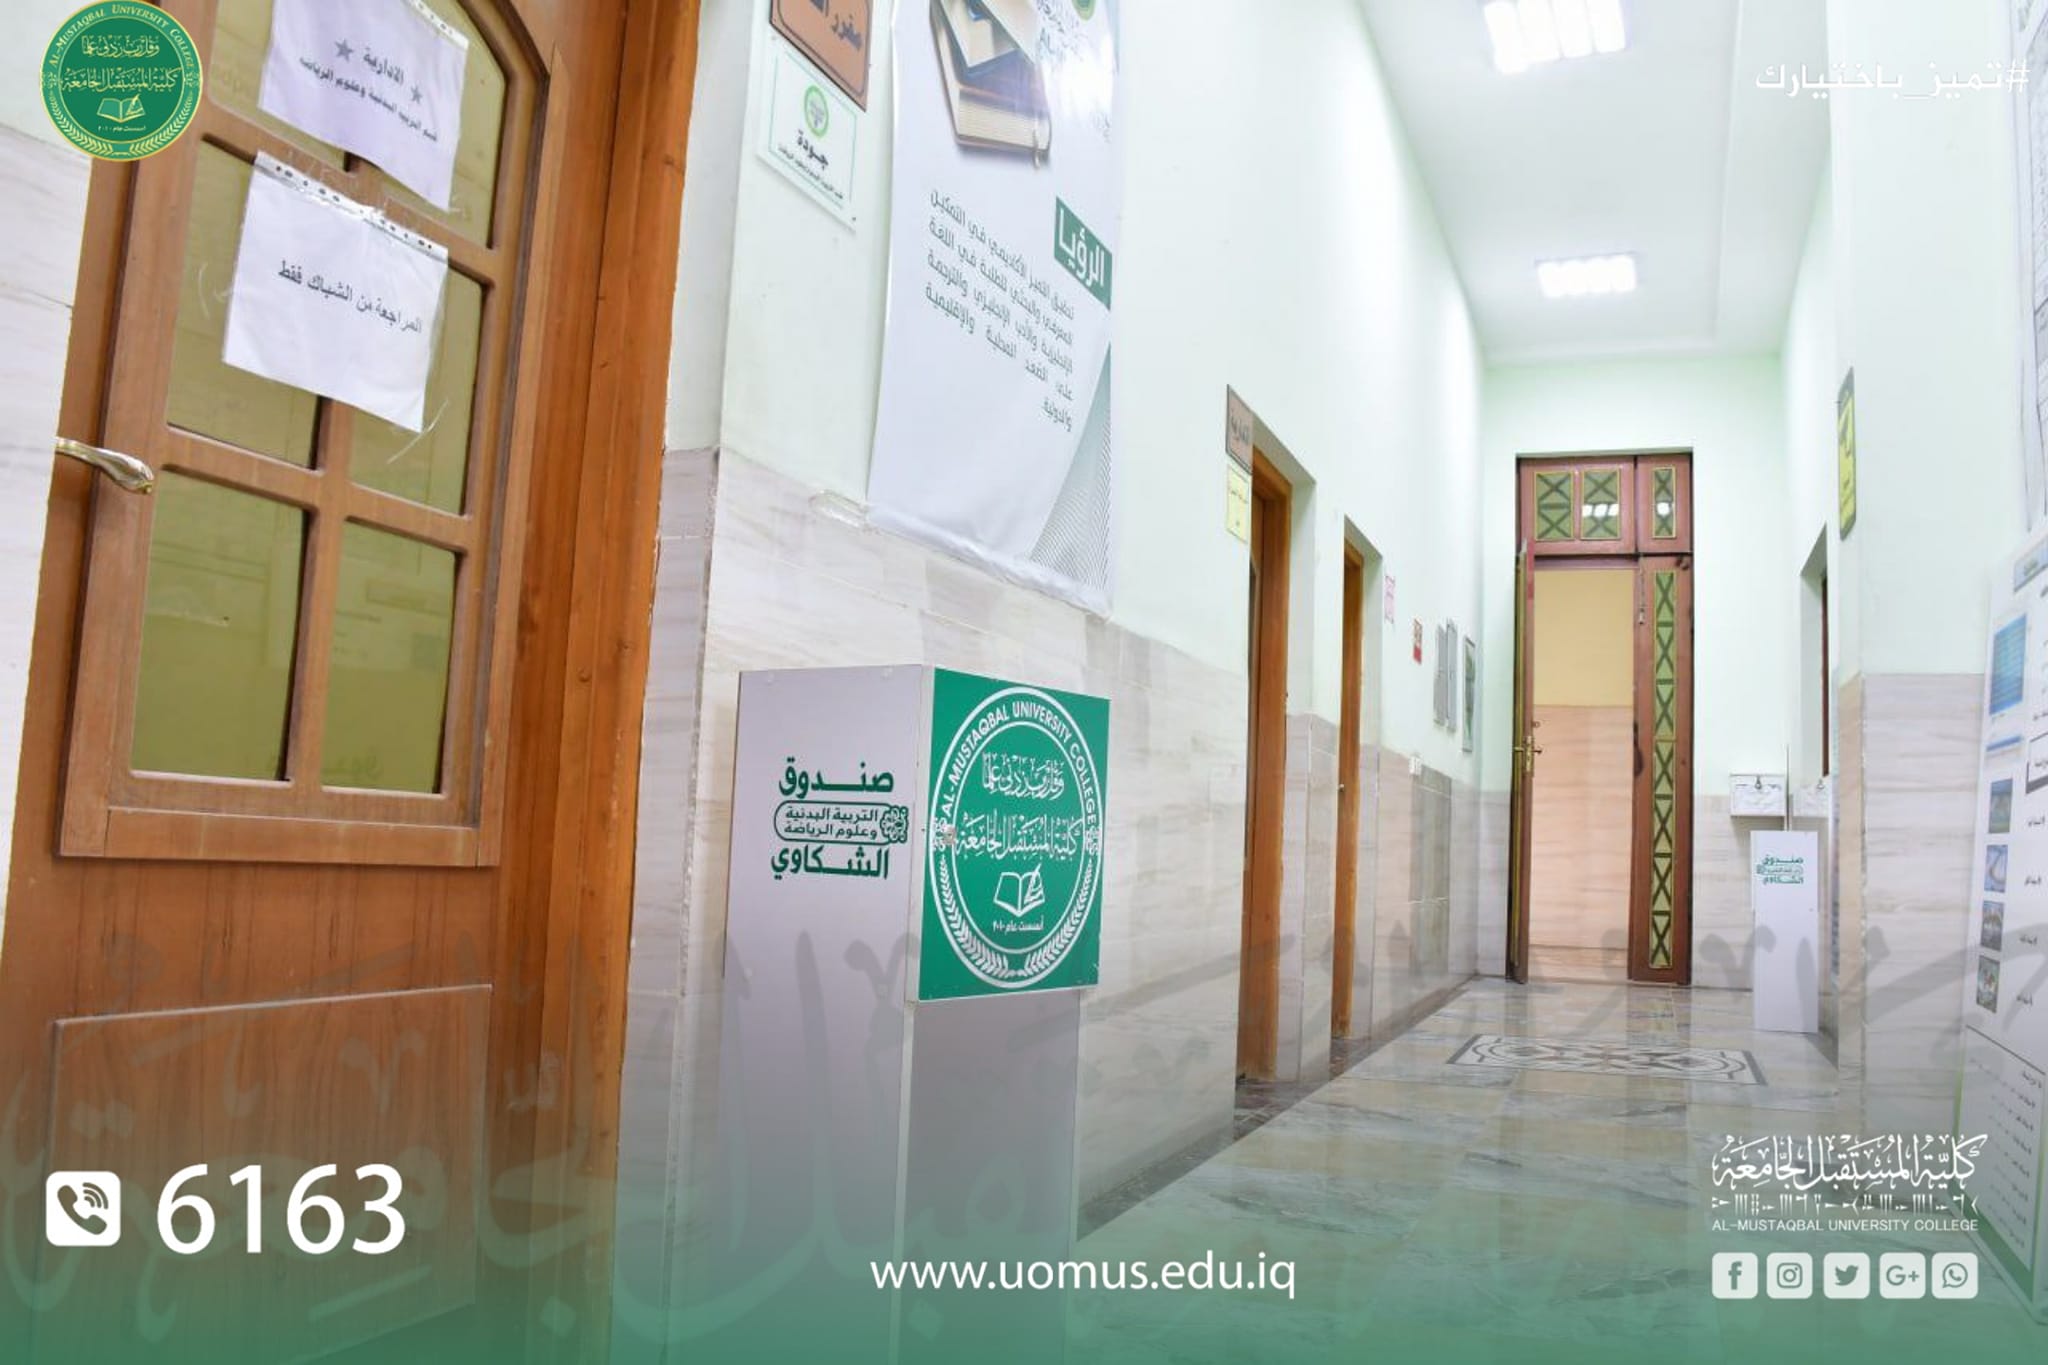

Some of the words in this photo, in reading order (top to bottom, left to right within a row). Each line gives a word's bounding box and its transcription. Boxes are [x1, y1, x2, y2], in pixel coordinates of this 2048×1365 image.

[1058, 207, 1106, 288] الرؤيا
[278, 259, 302, 285] فقط
[306, 274, 353, 302] الشباك
[942, 703, 1010, 813] AL-MUSTAQBAL
[1012, 701, 1073, 744] UNIVERSITY
[1069, 743, 1098, 825] COLLEGE
[778, 756, 894, 799] صندوق
[785, 806, 830, 822] البدنية
[832, 807, 879, 825] التربية
[783, 821, 833, 838] الرياضة
[835, 826, 878, 840] وعلوم
[770, 844, 889, 881] الشكاوي
